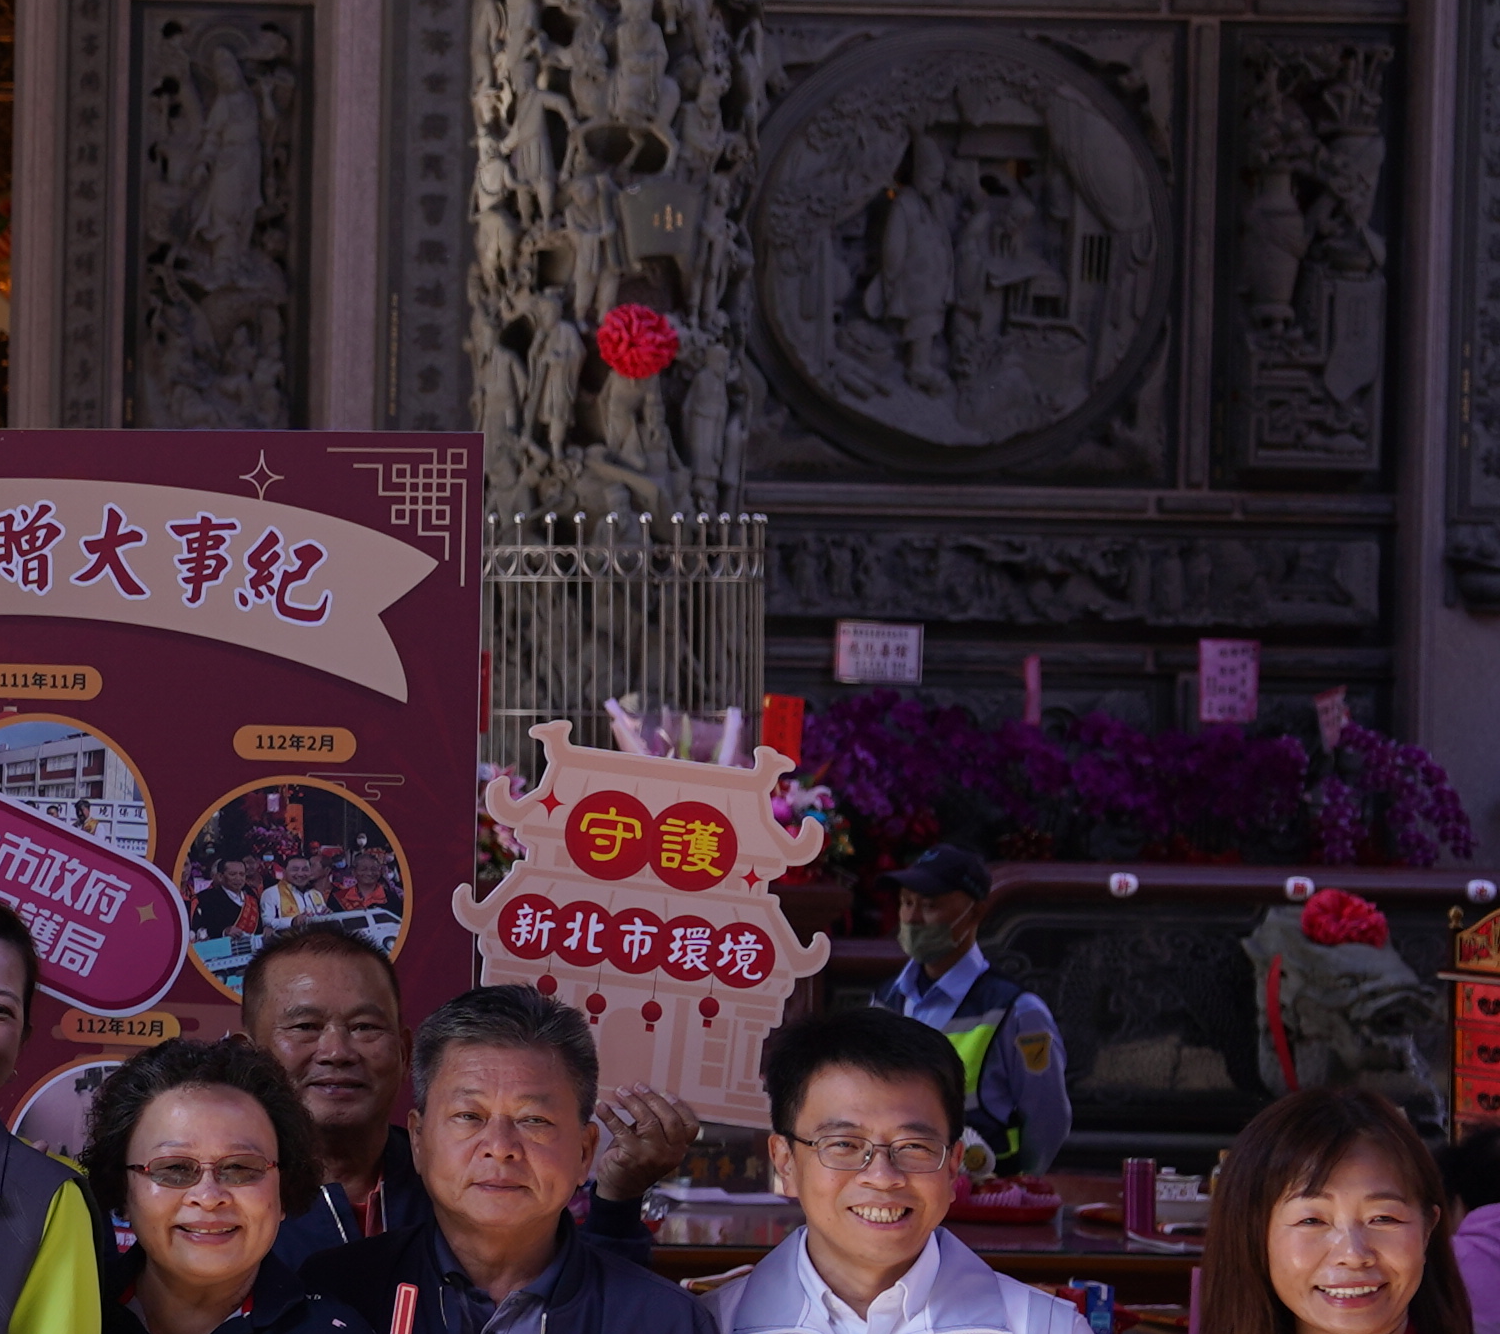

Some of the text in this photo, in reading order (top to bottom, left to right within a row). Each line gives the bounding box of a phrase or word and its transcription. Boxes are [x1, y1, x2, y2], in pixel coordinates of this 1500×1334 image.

[254, 732, 336, 755] 112年2月
[579, 806, 726, 878] 守護
[510, 902, 765, 982] 新北市環境
[76, 1018, 165, 1038] 112年12月
